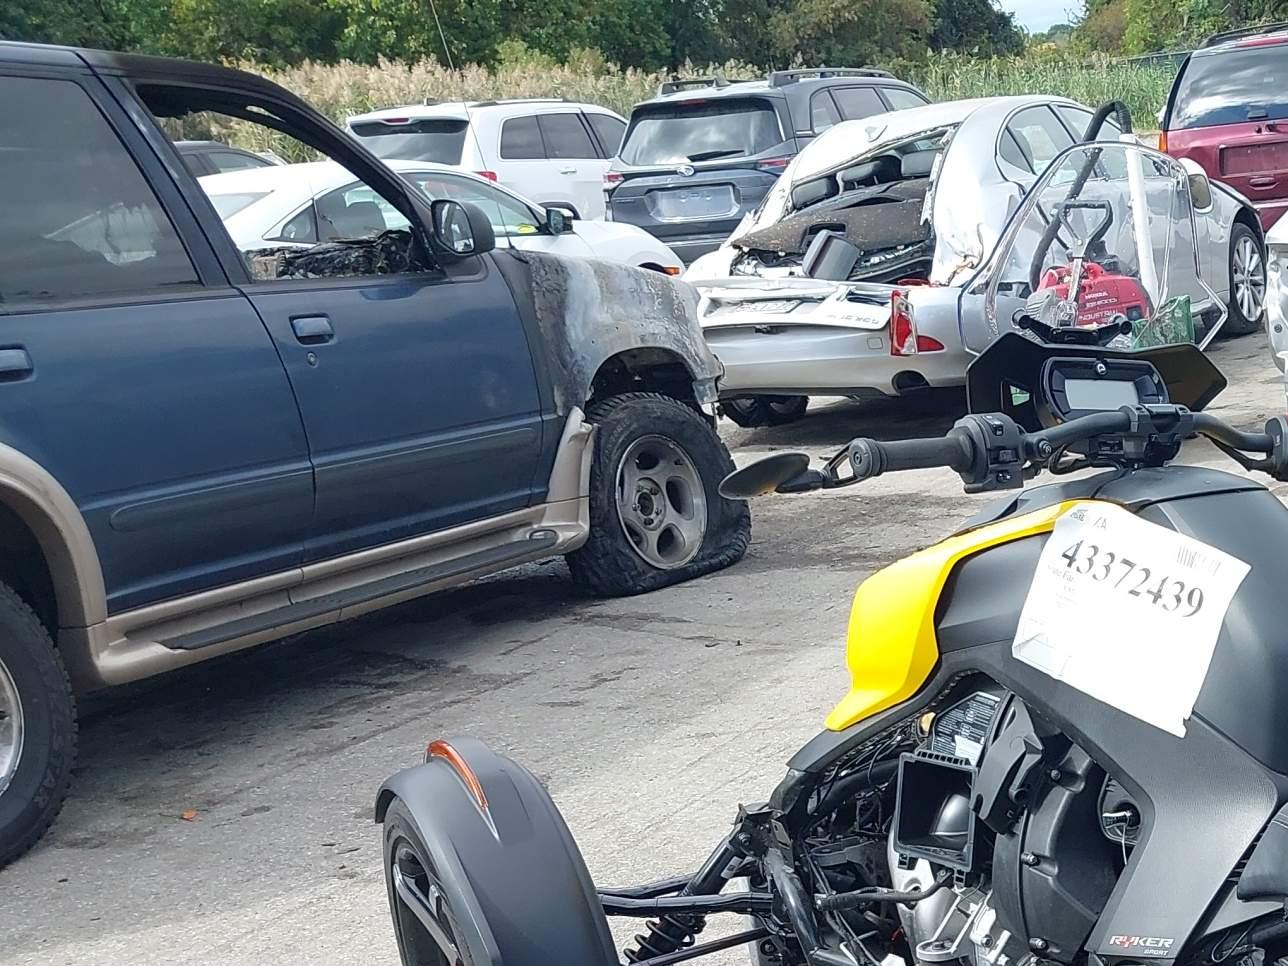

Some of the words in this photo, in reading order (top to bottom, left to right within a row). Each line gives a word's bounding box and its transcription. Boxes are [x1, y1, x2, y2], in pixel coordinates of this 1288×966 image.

[1061, 538, 1204, 618] 43372439
[1109, 935, 1175, 949] RYKER
[1143, 948, 1169, 956] SPORT
